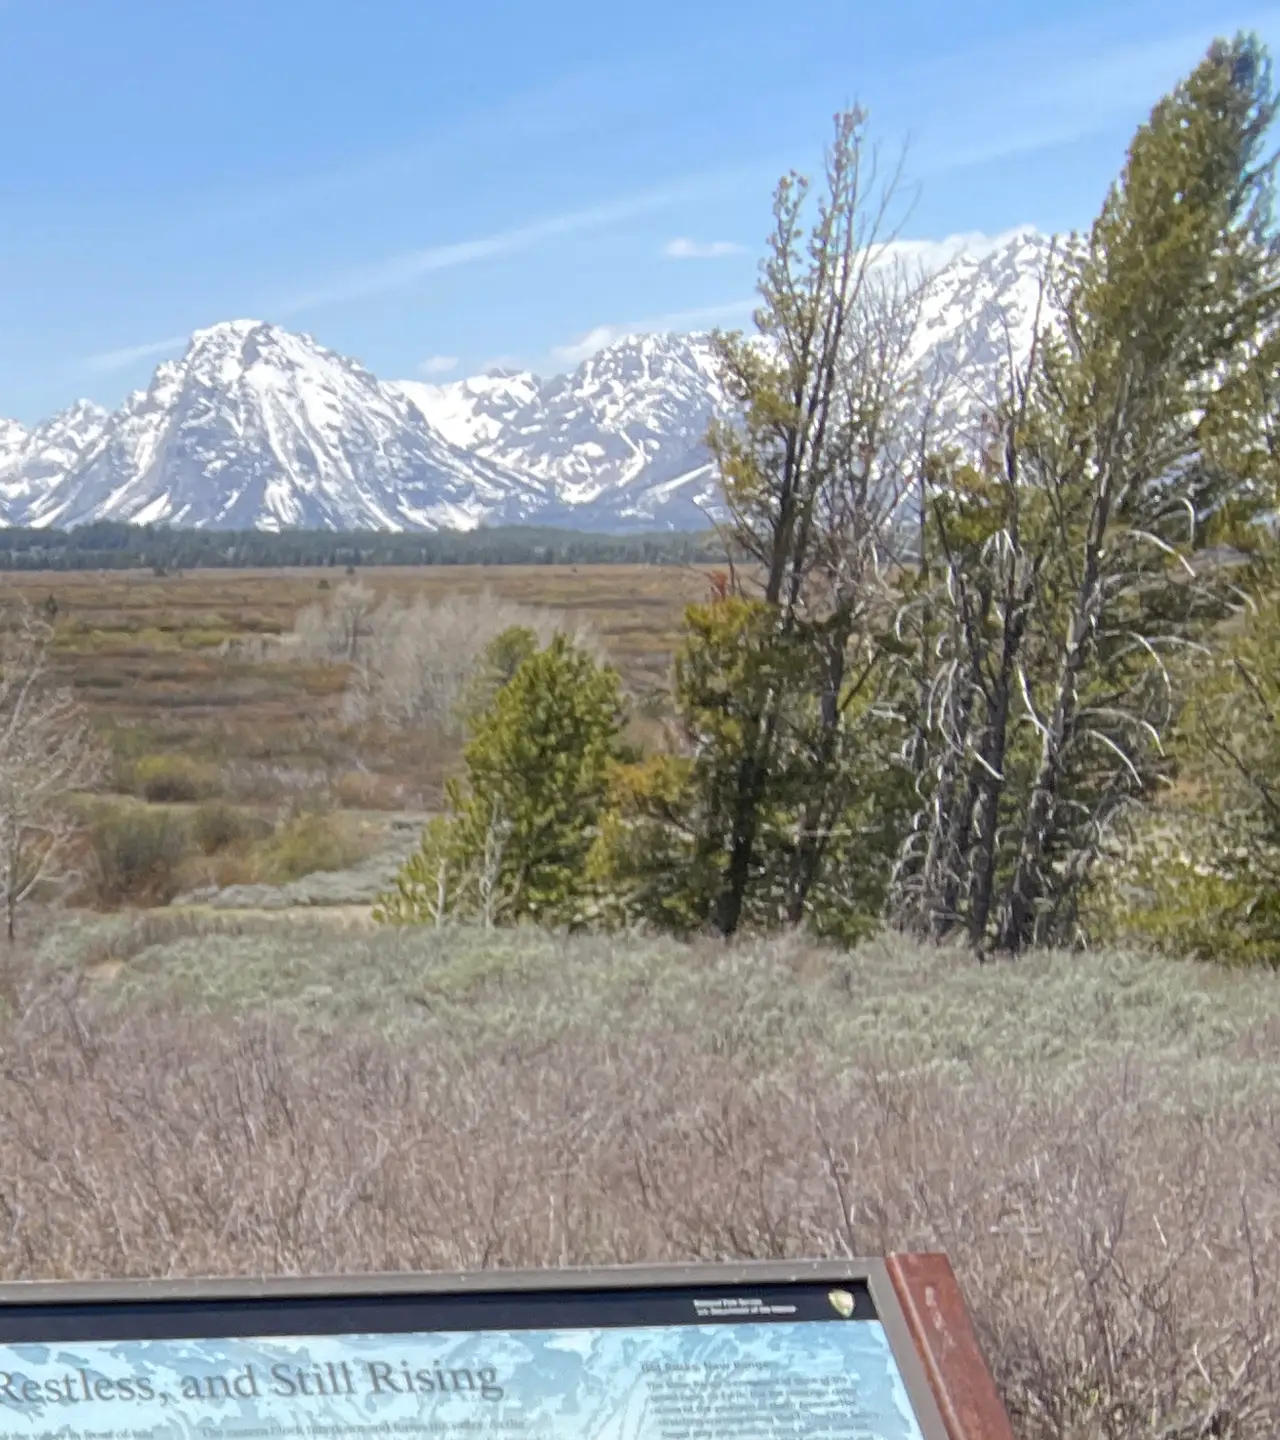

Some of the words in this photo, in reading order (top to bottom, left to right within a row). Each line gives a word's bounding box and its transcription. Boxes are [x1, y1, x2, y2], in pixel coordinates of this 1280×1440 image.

[180, 1365, 258, 1399] and
[271, 1359, 354, 1398] Still
[363, 1359, 504, 1402] Rising
